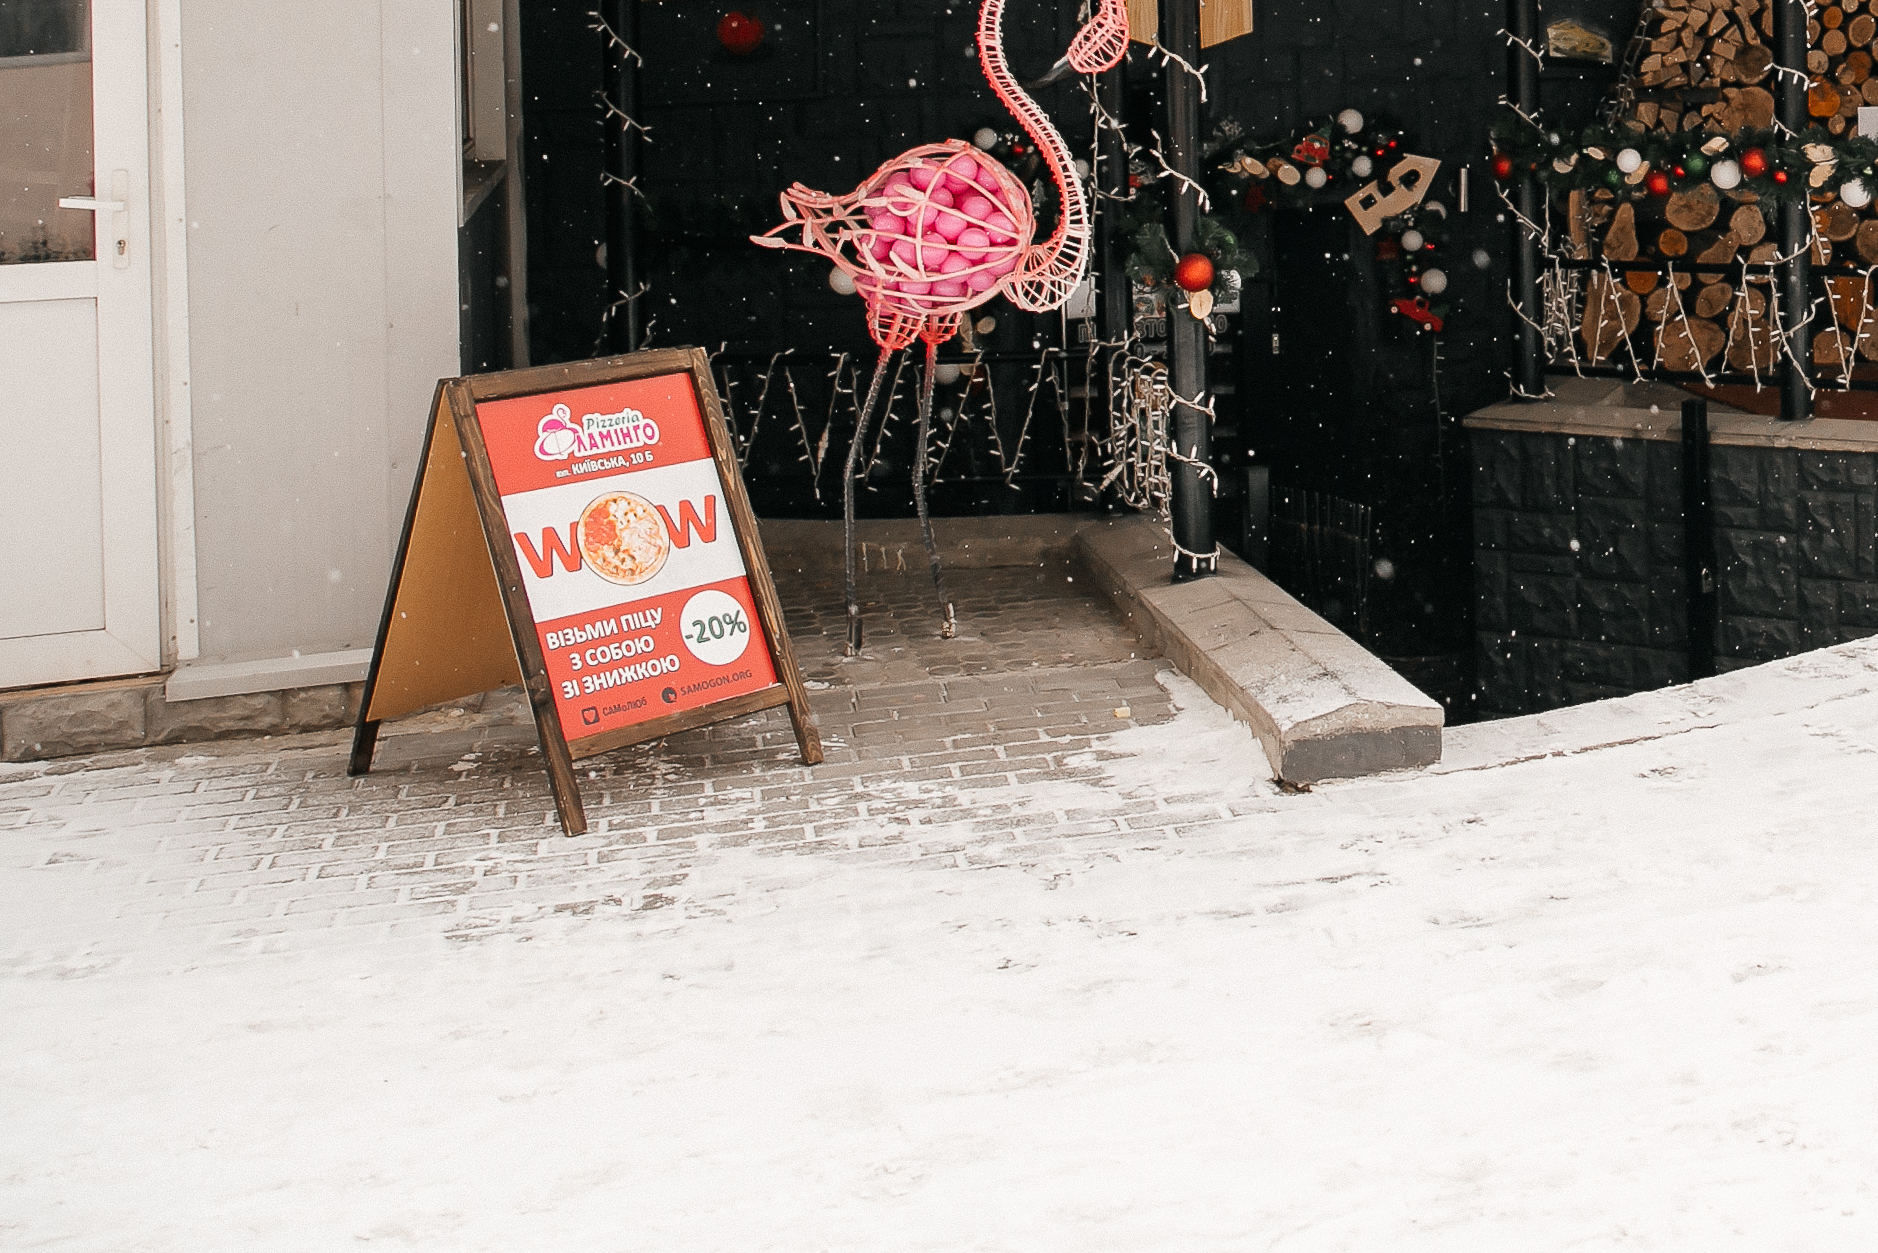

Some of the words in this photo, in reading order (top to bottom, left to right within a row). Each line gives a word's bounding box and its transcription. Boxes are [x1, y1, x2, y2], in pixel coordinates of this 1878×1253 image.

[585, 411, 640, 431] Pizzeria
[571, 454, 630, 475] КИЇВСЬКА,
[630, 451, 644, 465] 10
[644, 450, 654, 462] Б
[545, 617, 619, 650] ВІЗЬМИ
[620, 607, 664, 633] ПІЦУ
[684, 610, 747, 644] -20%
[569, 653, 583, 671] З
[585, 635, 655, 666] СОБОЮ
[561, 678, 580, 699] ЗІ
[581, 654, 680, 695] ЗНИЖКОЮ
[680, 669, 753, 696] SAMOGON.ORG
